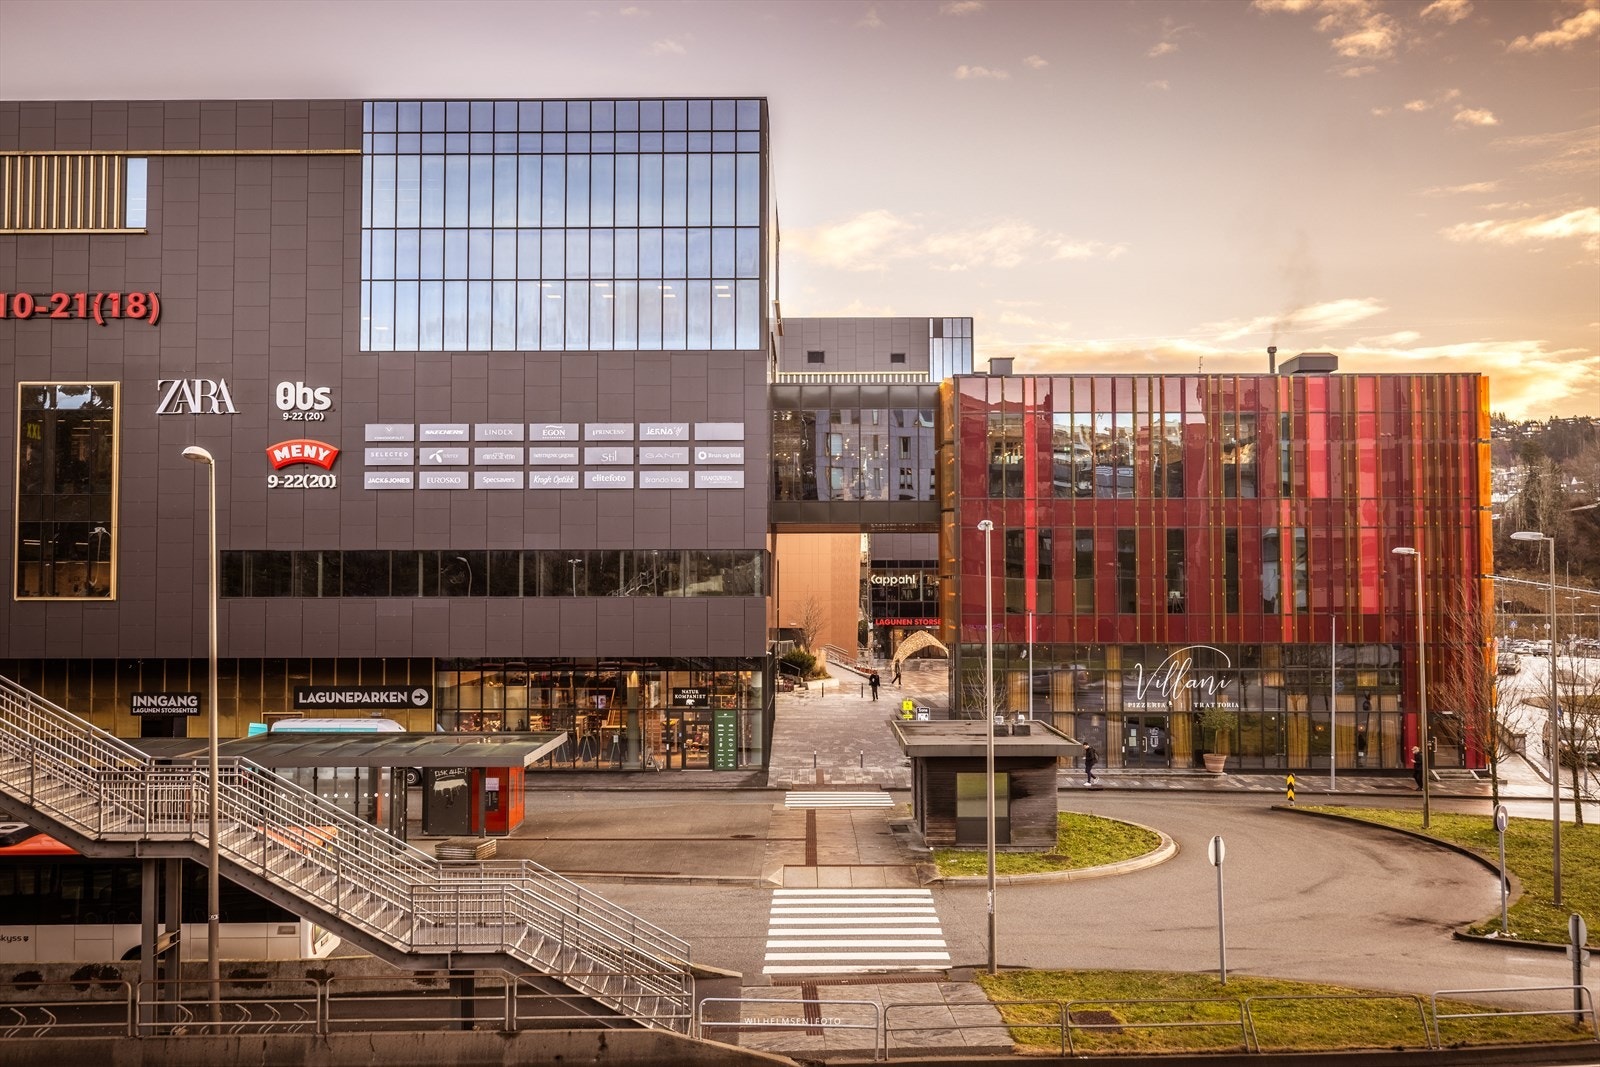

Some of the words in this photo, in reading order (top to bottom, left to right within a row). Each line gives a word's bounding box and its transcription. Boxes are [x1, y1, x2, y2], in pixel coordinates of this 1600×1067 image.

[155, 377, 240, 414] ZARA
[275, 381, 332, 411] Obs
[282, 412, 303, 420] 9-22
[304, 412, 325, 421] (20)
[27, 422, 41, 440] XXL
[542, 429, 566, 437] EGON
[273, 444, 331, 462] MENY
[601, 450, 616, 463] Stil
[267, 474, 337, 489] 9-22(20)
[482, 476, 515, 484] Specsavers
[533, 475, 553, 486] Krogh
[553, 475, 576, 485] Optikk
[592, 474, 626, 482] elitefoto
[875, 618, 913, 626] LAGUNEN
[1134, 645, 1231, 700] Villani
[132, 695, 198, 707] INNGANG
[298, 691, 408, 704] LAGUNEPARKEN
[0, 934, 22, 944] kyss
